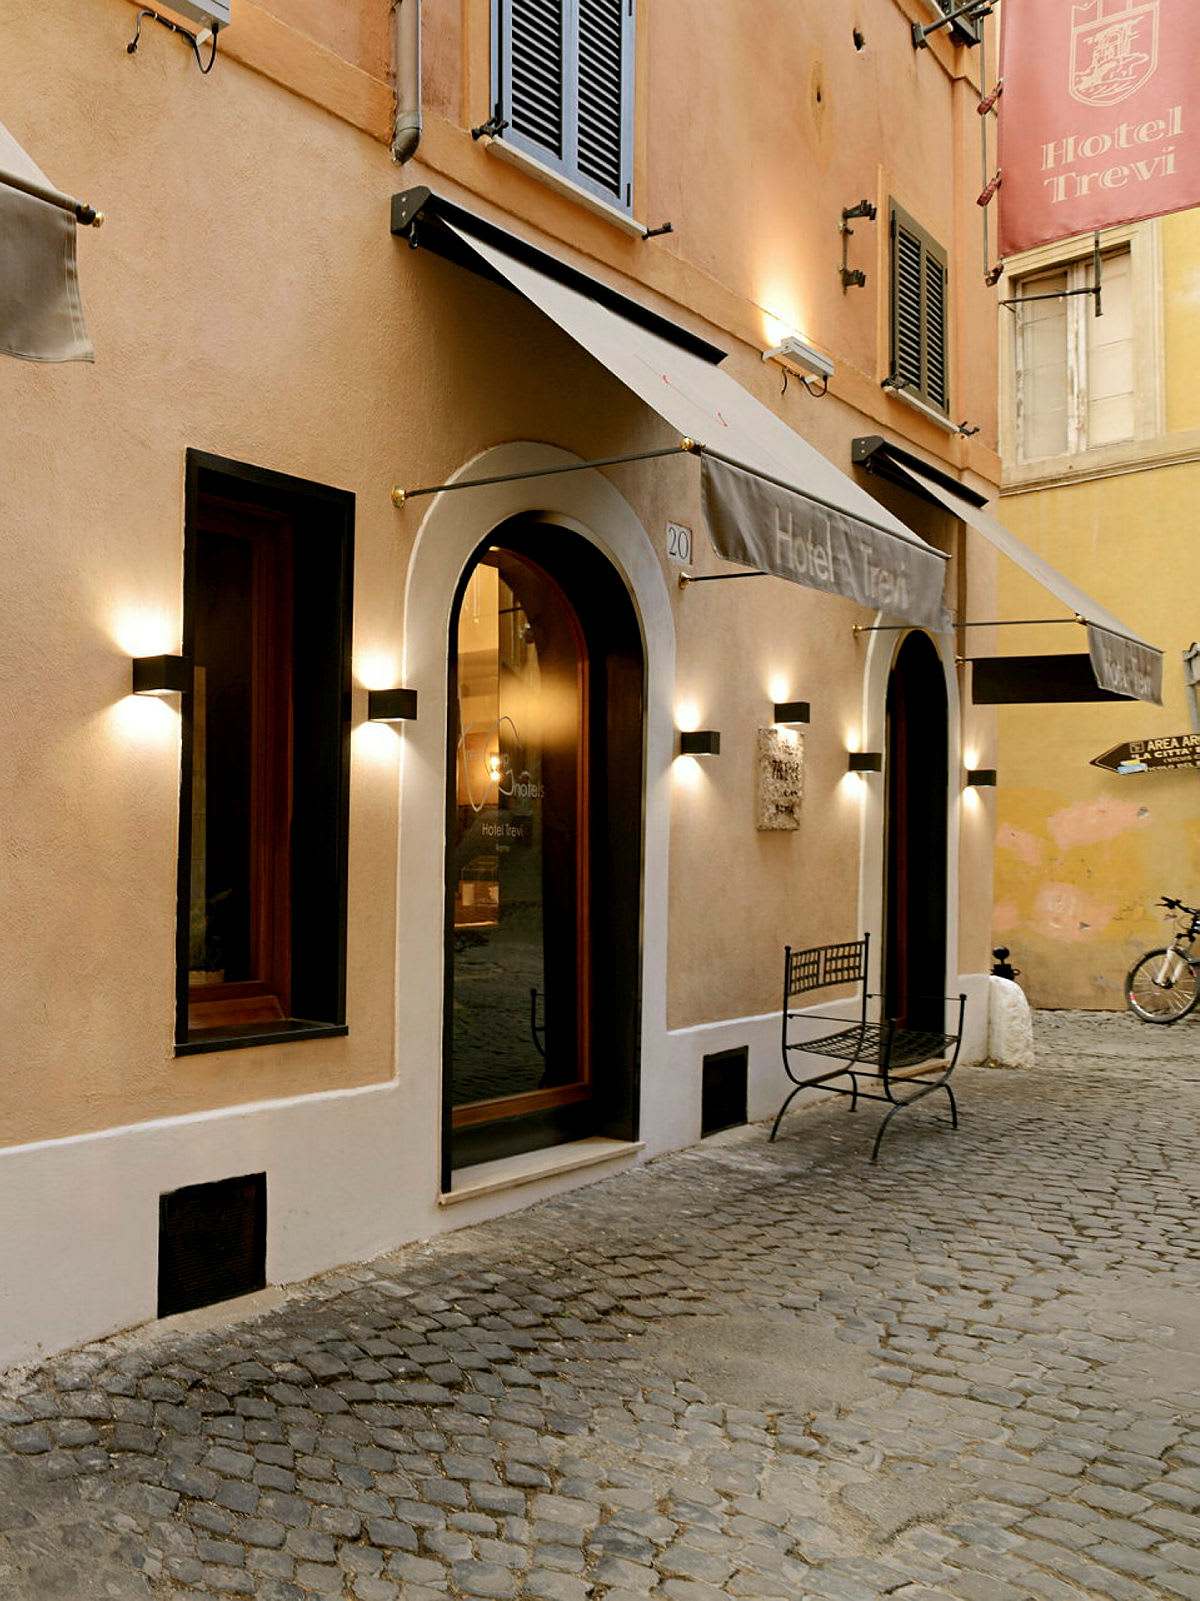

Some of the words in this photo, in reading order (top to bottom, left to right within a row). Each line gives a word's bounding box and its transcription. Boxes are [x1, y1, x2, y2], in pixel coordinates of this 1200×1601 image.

[1040, 105, 1185, 172] Hotel
[1043, 145, 1178, 205] Trevi
[667, 526, 690, 560] 20
[774, 505, 836, 584] Hotel
[860, 542, 909, 610] Trevi
[1147, 738, 1180, 751] AREA
